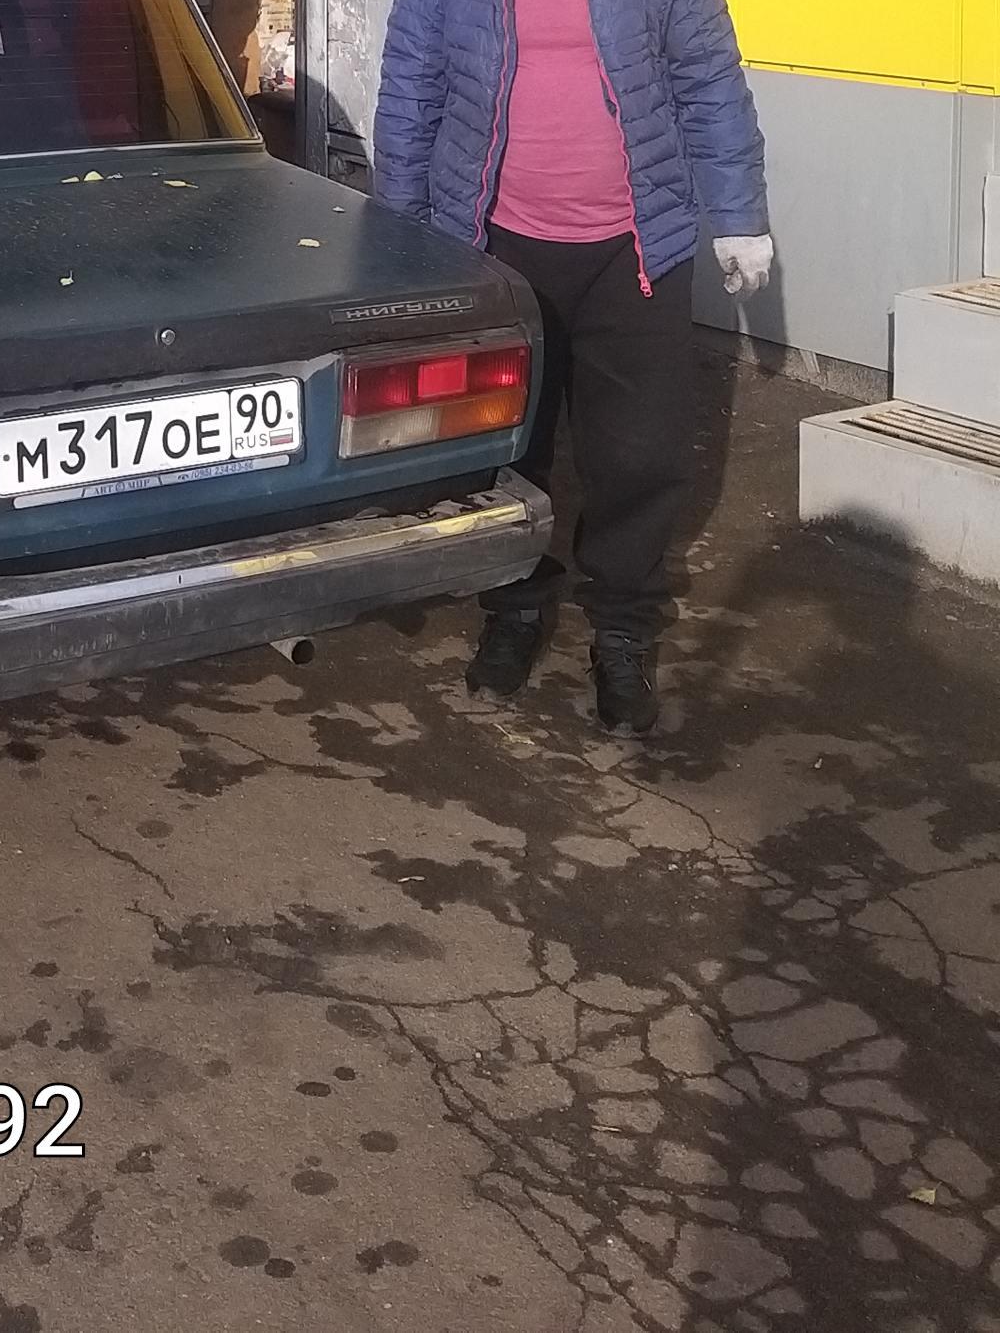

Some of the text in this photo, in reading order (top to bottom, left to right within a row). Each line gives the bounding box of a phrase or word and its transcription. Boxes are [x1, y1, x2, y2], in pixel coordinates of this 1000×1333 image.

[346, 299, 460, 319] ЖИГУЛИ
[236, 390, 282, 433] 90
[16, 411, 221, 483] М317ОЕ
[235, 432, 268, 450] RUS
